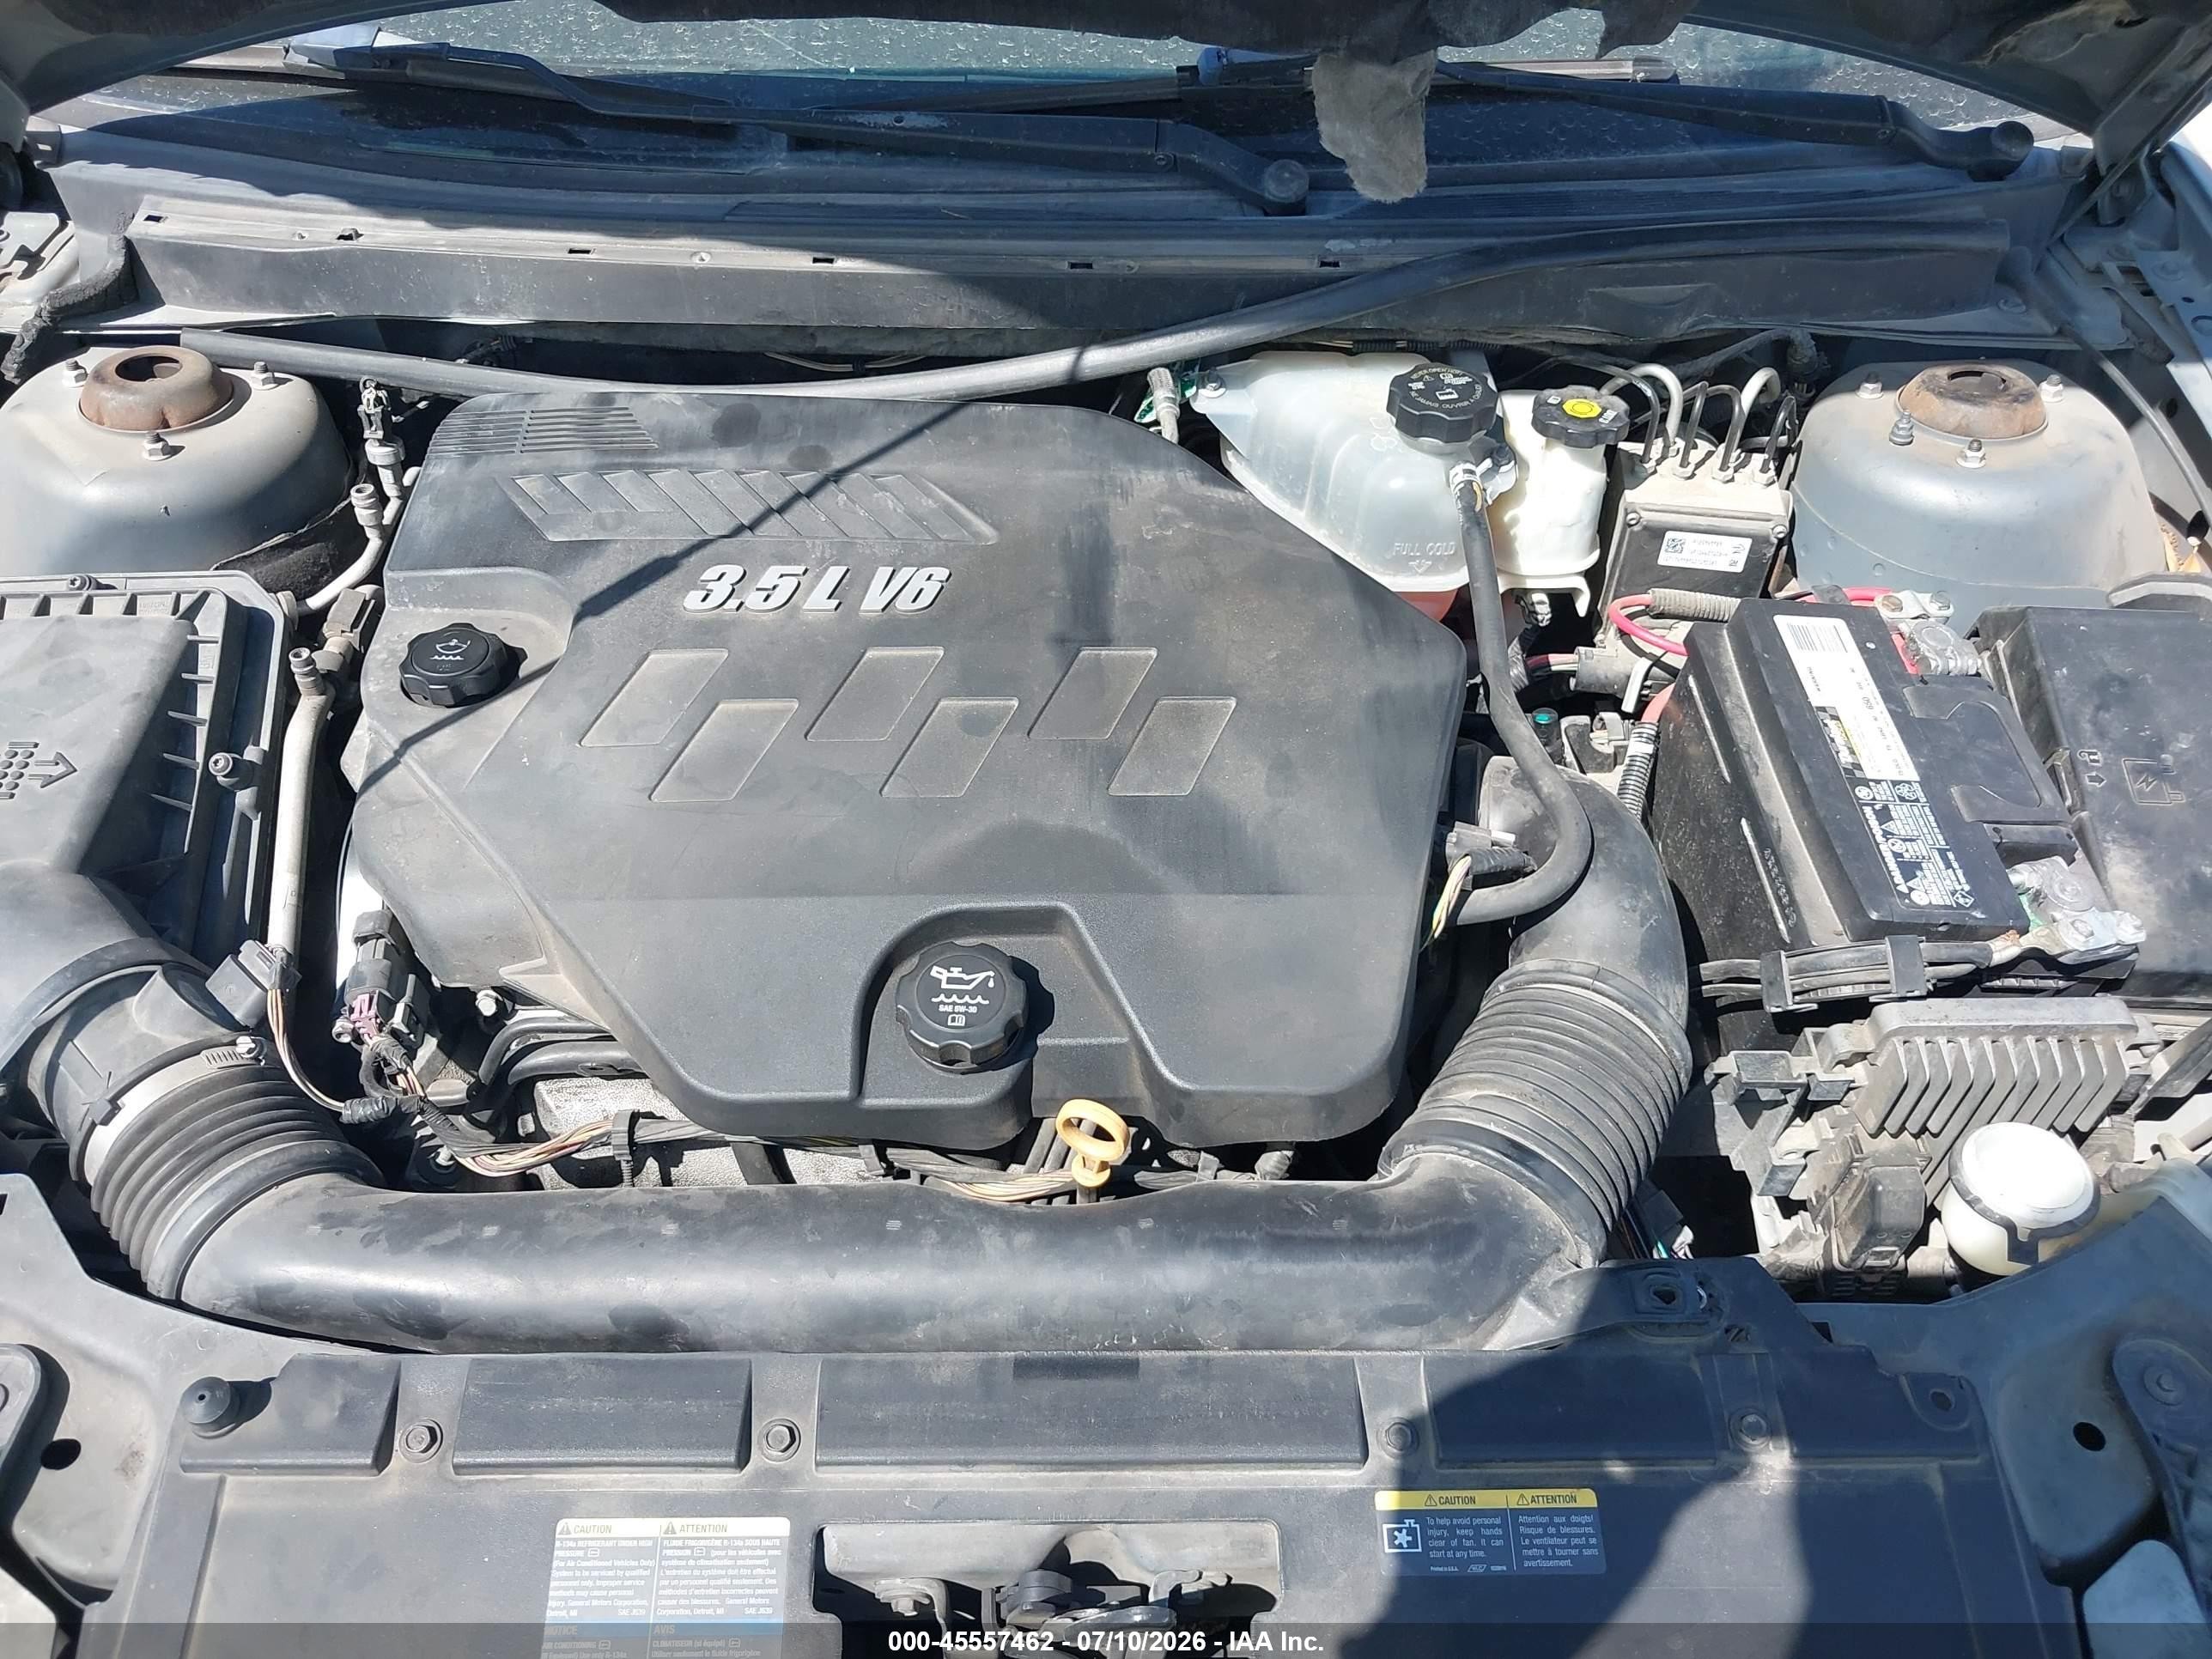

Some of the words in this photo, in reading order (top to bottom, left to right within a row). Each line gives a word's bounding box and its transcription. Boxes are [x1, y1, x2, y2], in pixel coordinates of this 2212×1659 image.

[1393, 543, 1421, 556] FULL
[1426, 542, 1455, 556] COLD
[859, 566, 952, 616] V6
[939, 1004, 954, 1012] SAE
[954, 1005, 977, 1013] 5W-30
[1438, 1496, 1476, 1504] CAUTION
[1530, 1494, 1577, 1504] ATTENTION
[1425, 1516, 1435, 1525] To
[1436, 1516, 1450, 1526] help
[1452, 1516, 1470, 1525] avoid
[1472, 1516, 1501, 1526] personal
[1518, 1515, 1549, 1523] Attention
[1570, 1514, 1594, 1524] doigts!
[574, 1524, 612, 1534] CAUTION
[679, 1524, 728, 1533] ATTENTION
[1455, 1528, 1474, 1536] keep
[1480, 1527, 1503, 1535] hands
[1519, 1526, 1543, 1534] Risque
[1547, 1525, 1556, 1534] de
[1559, 1525, 1595, 1534] blessures.
[1428, 1538, 1445, 1547] clear
[1450, 1538, 1457, 1547] of
[1532, 1536, 1567, 1545] ventilateur
[1571, 1536, 1586, 1546] peut
[1429, 1549, 1445, 1558] start
[1547, 1547, 1553, 1556] à
[1554, 1547, 1579, 1556] tourner
[1523, 1559, 1573, 1567] avertissement.
[654, 1624, 676, 1635] AVIS
